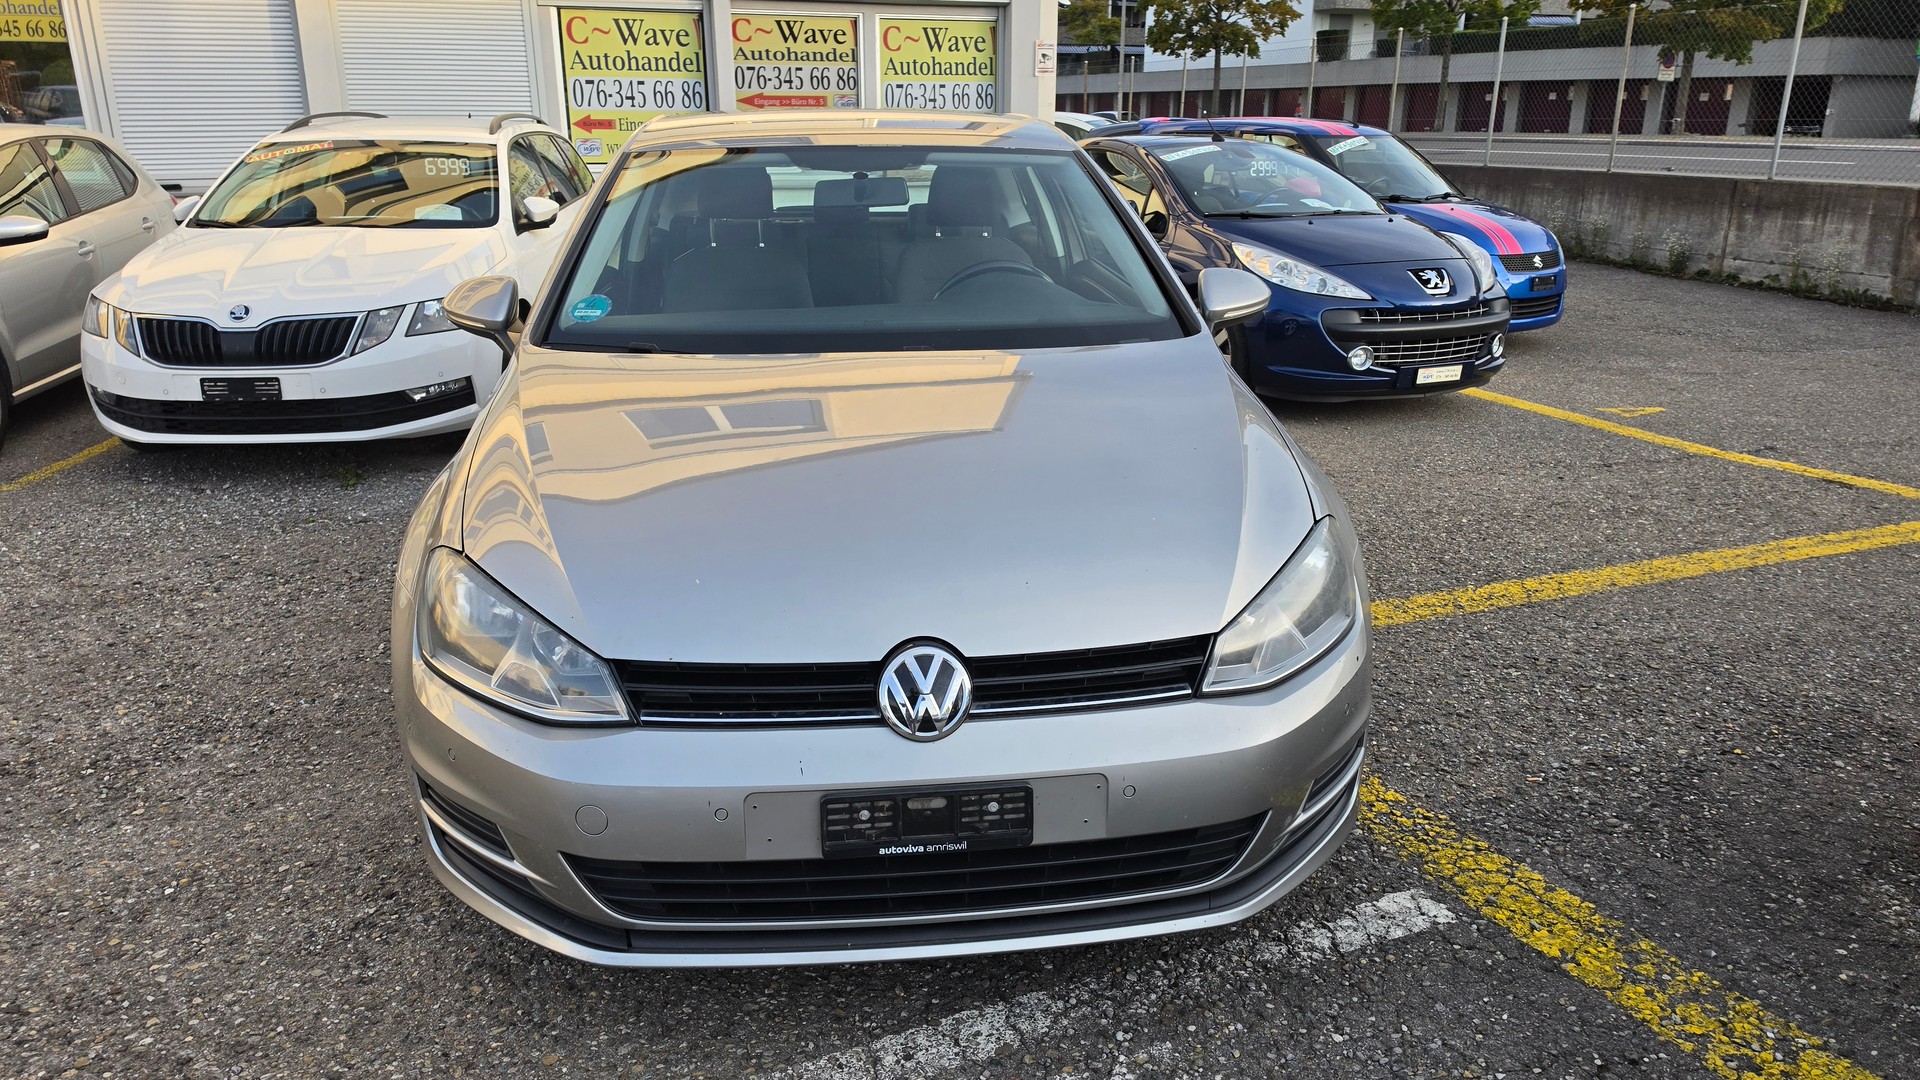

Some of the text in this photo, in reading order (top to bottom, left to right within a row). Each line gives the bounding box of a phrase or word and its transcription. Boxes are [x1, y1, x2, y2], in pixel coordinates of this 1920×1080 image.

[0, 19, 67, 39] 45 66 86
[570, 50, 702, 73] Autohandel
[733, 46, 857, 63] Autohandel
[884, 56, 995, 76] Autohandel
[734, 65, 857, 91] 076-345 66 86
[572, 78, 703, 109] 076-345 66 86
[754, 97, 780, 106] Eingang
[791, 96, 807, 105] Büro
[885, 83, 994, 110] 076-345 66 86
[247, 140, 334, 162] AUTOMAT
[1250, 161, 1278, 177] 2999
[879, 841, 967, 855] autoviva amriswil
